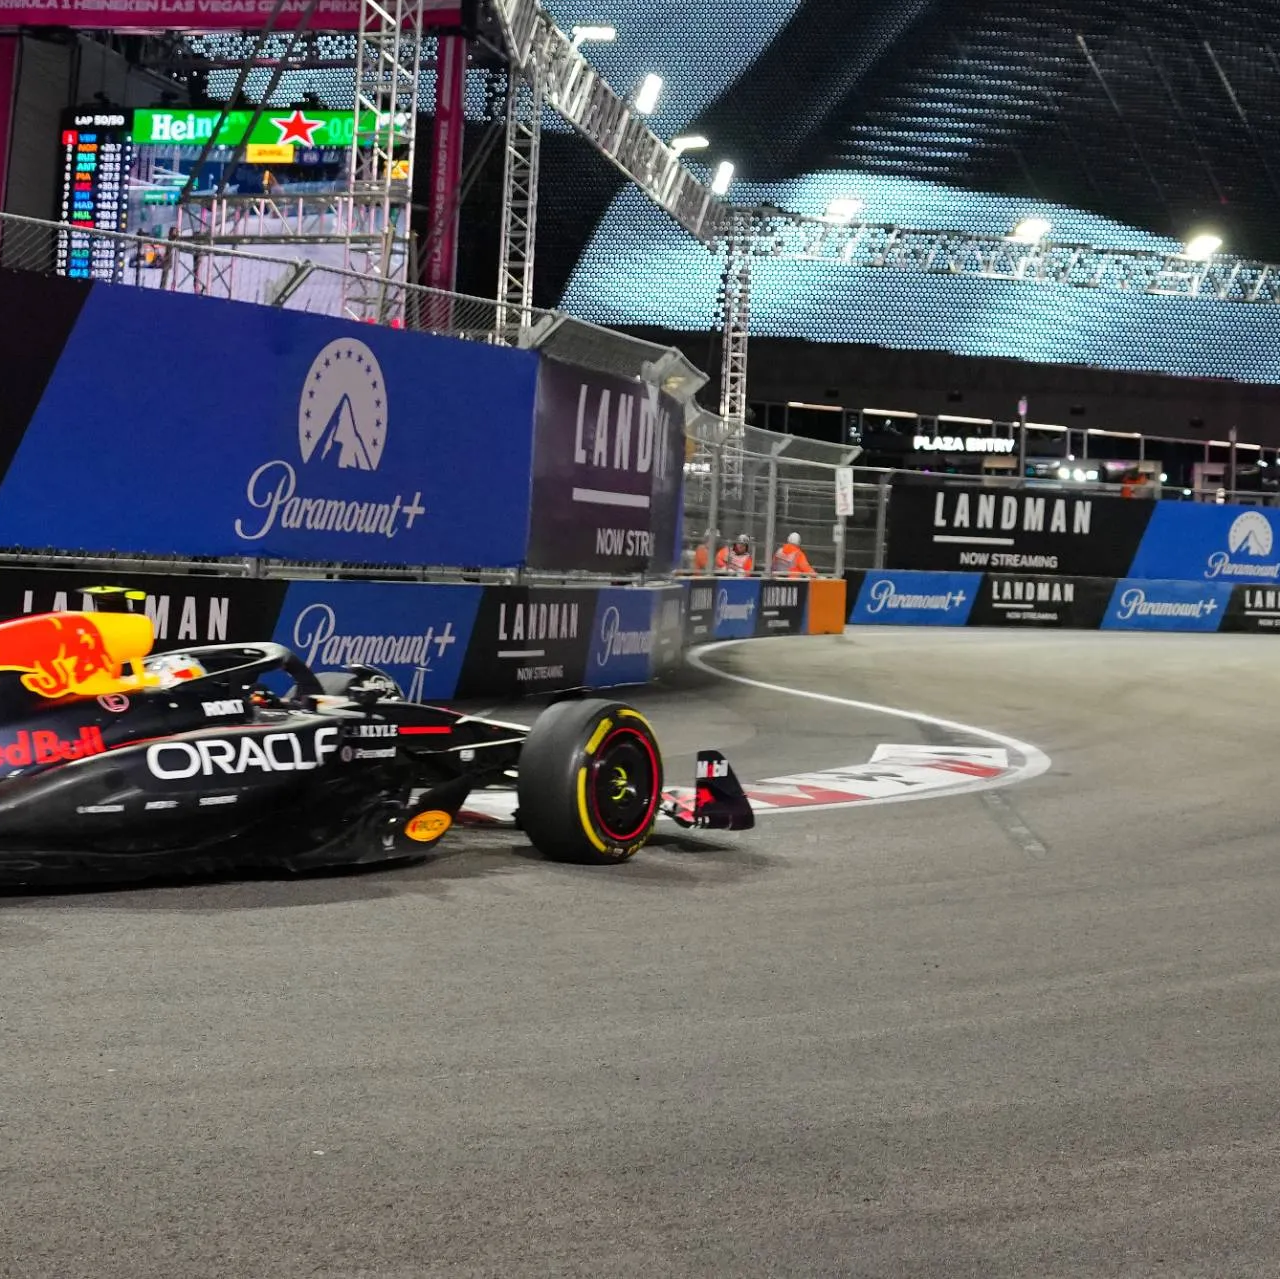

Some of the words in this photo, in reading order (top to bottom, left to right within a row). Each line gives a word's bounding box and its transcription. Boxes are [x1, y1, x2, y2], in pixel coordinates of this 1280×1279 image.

[198, 0, 257, 13] VEGAS
[320, 0, 360, 13] PRIX
[75, 116, 93, 126] LAP
[913, 436, 964, 451] PLAZA
[966, 437, 1015, 453] ENTRY
[234, 460, 425, 540] Paramount+
[934, 492, 1092, 534] LANDMAN
[596, 528, 624, 555] NOW
[959, 552, 988, 565] NOW
[991, 553, 1058, 568] STREAMING
[867, 580, 966, 614] Paramount+
[992, 580, 1075, 602] LANDMAN
[1117, 588, 1218, 620] Paramount+
[294, 603, 457, 668] Paramount+
[499, 603, 579, 640] LANDMAN
[32, 726, 107, 764] Bull
